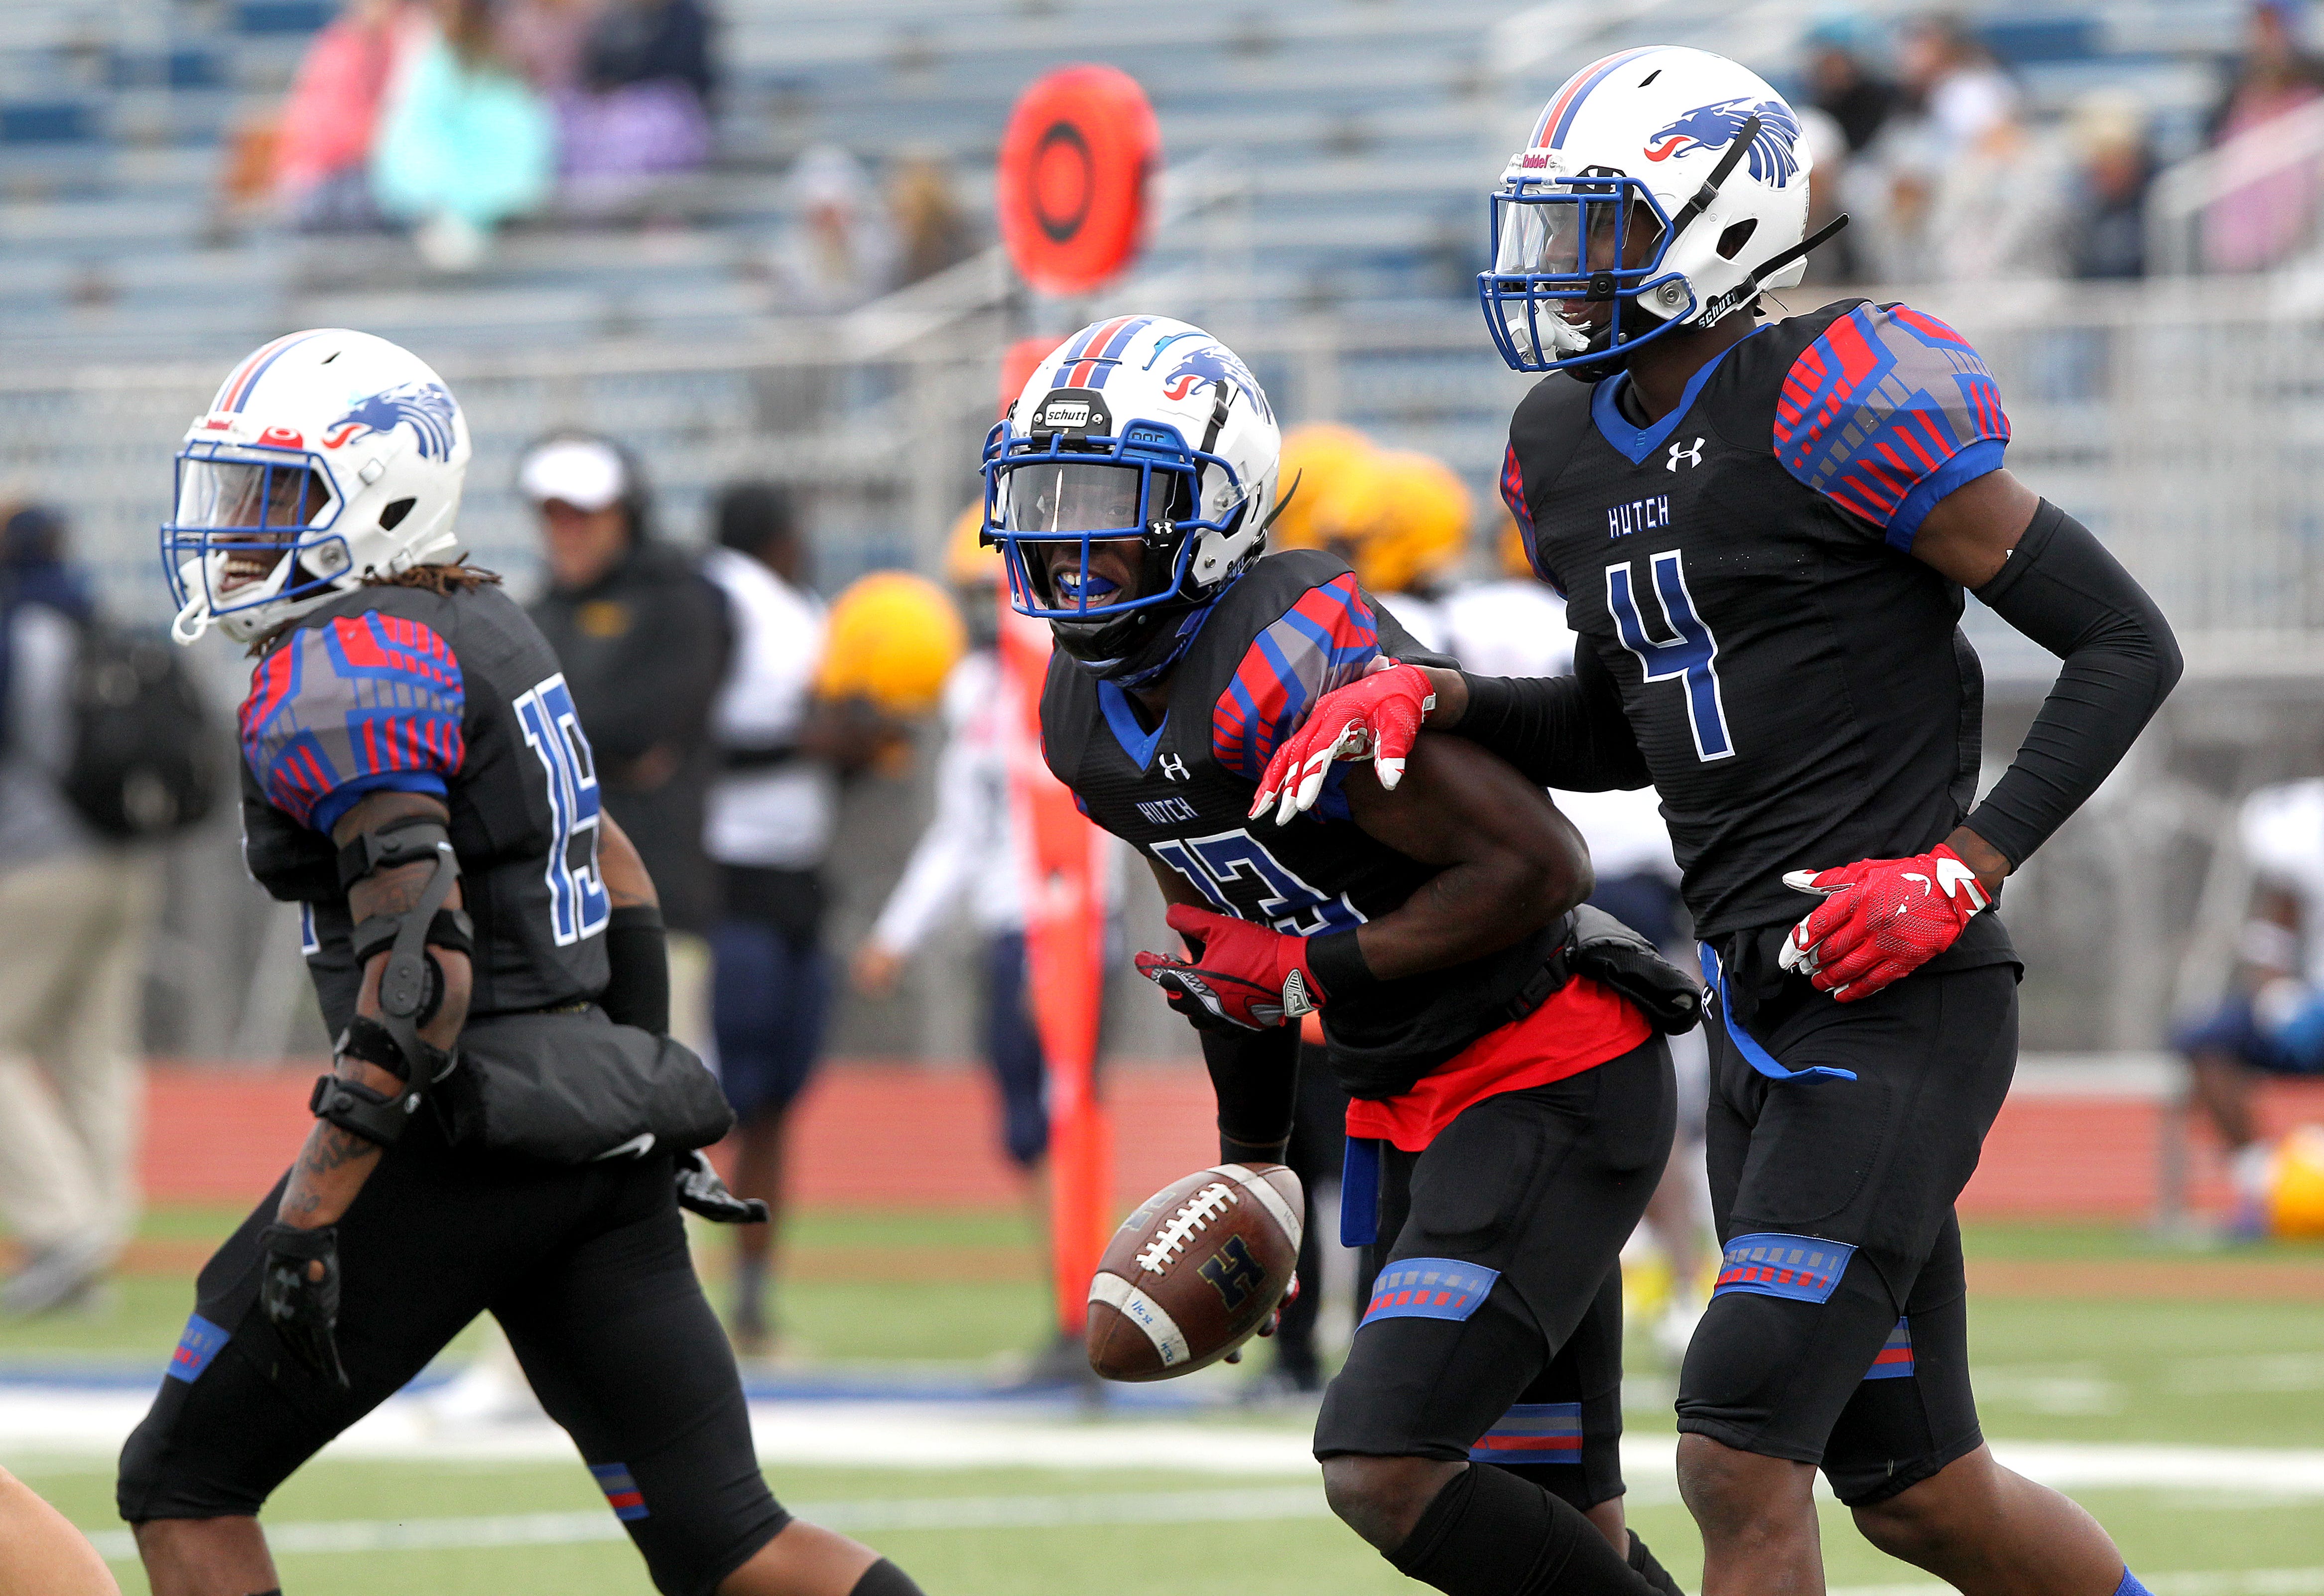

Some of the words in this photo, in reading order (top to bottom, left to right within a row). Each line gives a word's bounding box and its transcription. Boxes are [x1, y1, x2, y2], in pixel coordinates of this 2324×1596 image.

[1047, 409, 1087, 420] schutt
[1607, 494, 1670, 538] HUTCH
[1605, 548, 1735, 763] 4
[513, 672, 611, 947] 19
[1135, 796, 1199, 824] HUTCH
[1149, 827, 1368, 937] 13
[1197, 1234, 1269, 1313] H
